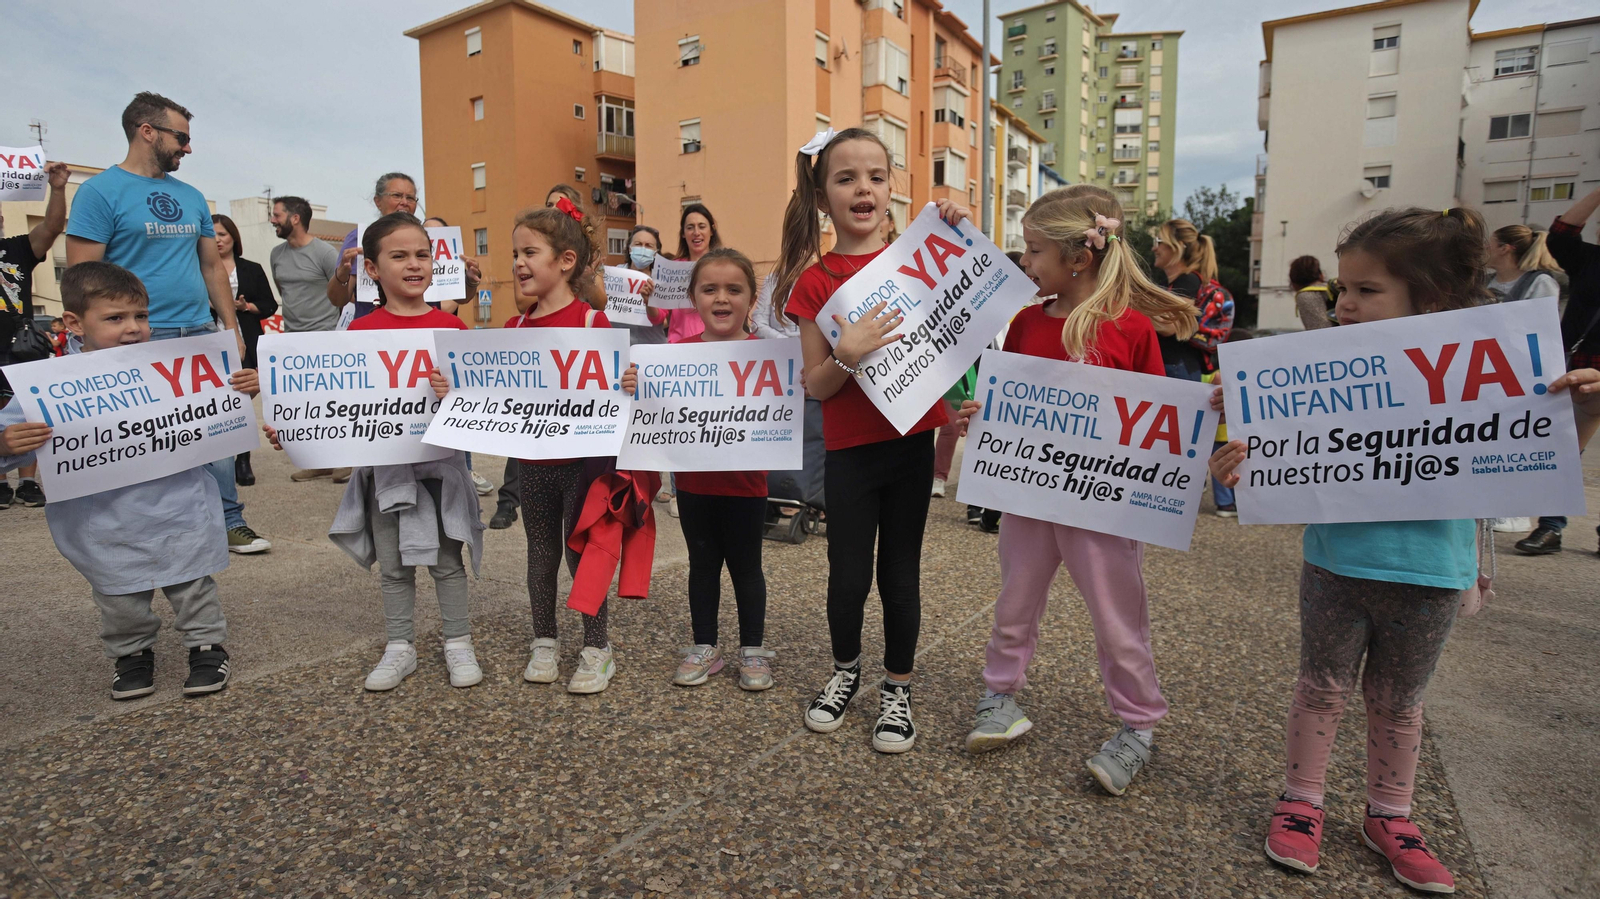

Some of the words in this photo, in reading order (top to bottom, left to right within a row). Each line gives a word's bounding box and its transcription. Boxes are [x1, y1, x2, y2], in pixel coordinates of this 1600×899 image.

[0, 171, 31, 180] ridad
[145, 222, 196, 234] Element
[430, 238, 458, 260] A!
[448, 264, 460, 274] de
[847, 280, 899, 324] OMEDOR
[865, 356, 891, 385] Por
[892, 346, 905, 365] la
[901, 270, 972, 352] Seguridad
[972, 252, 992, 277] de
[283, 371, 375, 392] INFANTIL
[464, 369, 547, 388] INFANTIL
[883, 349, 935, 403] nuestros
[644, 380, 724, 398] INFANTIL
[55, 385, 160, 423] INFANTIL
[273, 404, 300, 421] Por
[305, 402, 320, 419] la
[325, 397, 426, 421] Seguridad
[431, 398, 442, 414] d
[450, 397, 480, 414] Por
[482, 400, 498, 414] la
[501, 398, 594, 419] Seguridad
[598, 400, 620, 417] de
[1259, 381, 1404, 420] INFANTIL
[52, 434, 88, 454] Por
[94, 427, 112, 445] la
[118, 398, 217, 438] Seguridad
[222, 395, 242, 412] de
[443, 417, 518, 433] nuestros
[632, 409, 658, 425] Por
[661, 407, 674, 423] la
[678, 405, 769, 427] Seguridad
[772, 405, 793, 422] de
[998, 401, 1102, 440] INFANTIL
[277, 424, 346, 442] nuestros
[630, 430, 696, 444] nuestros
[1247, 435, 1289, 459] Por
[1296, 431, 1320, 456] la
[1328, 413, 1499, 457] Seguridad
[1510, 410, 1552, 439] de
[56, 443, 146, 474] nuestros
[977, 431, 1012, 454] Por
[1015, 437, 1034, 459] la
[1039, 443, 1160, 483] Seguridad
[1162, 466, 1190, 490] de
[1472, 455, 1504, 465] AMPA
[1507, 453, 1527, 462] ICA
[1530, 451, 1555, 461] CEIP
[1472, 466, 1500, 474] Isabel
[1516, 462, 1557, 472] Católica
[974, 459, 1059, 489] nuestros
[1251, 462, 1363, 488] nuestros
[1130, 499, 1148, 507] Isabel
[1131, 491, 1152, 501] AMPA
[1154, 495, 1166, 504] ICA
[1168, 499, 1185, 507] CEIP
